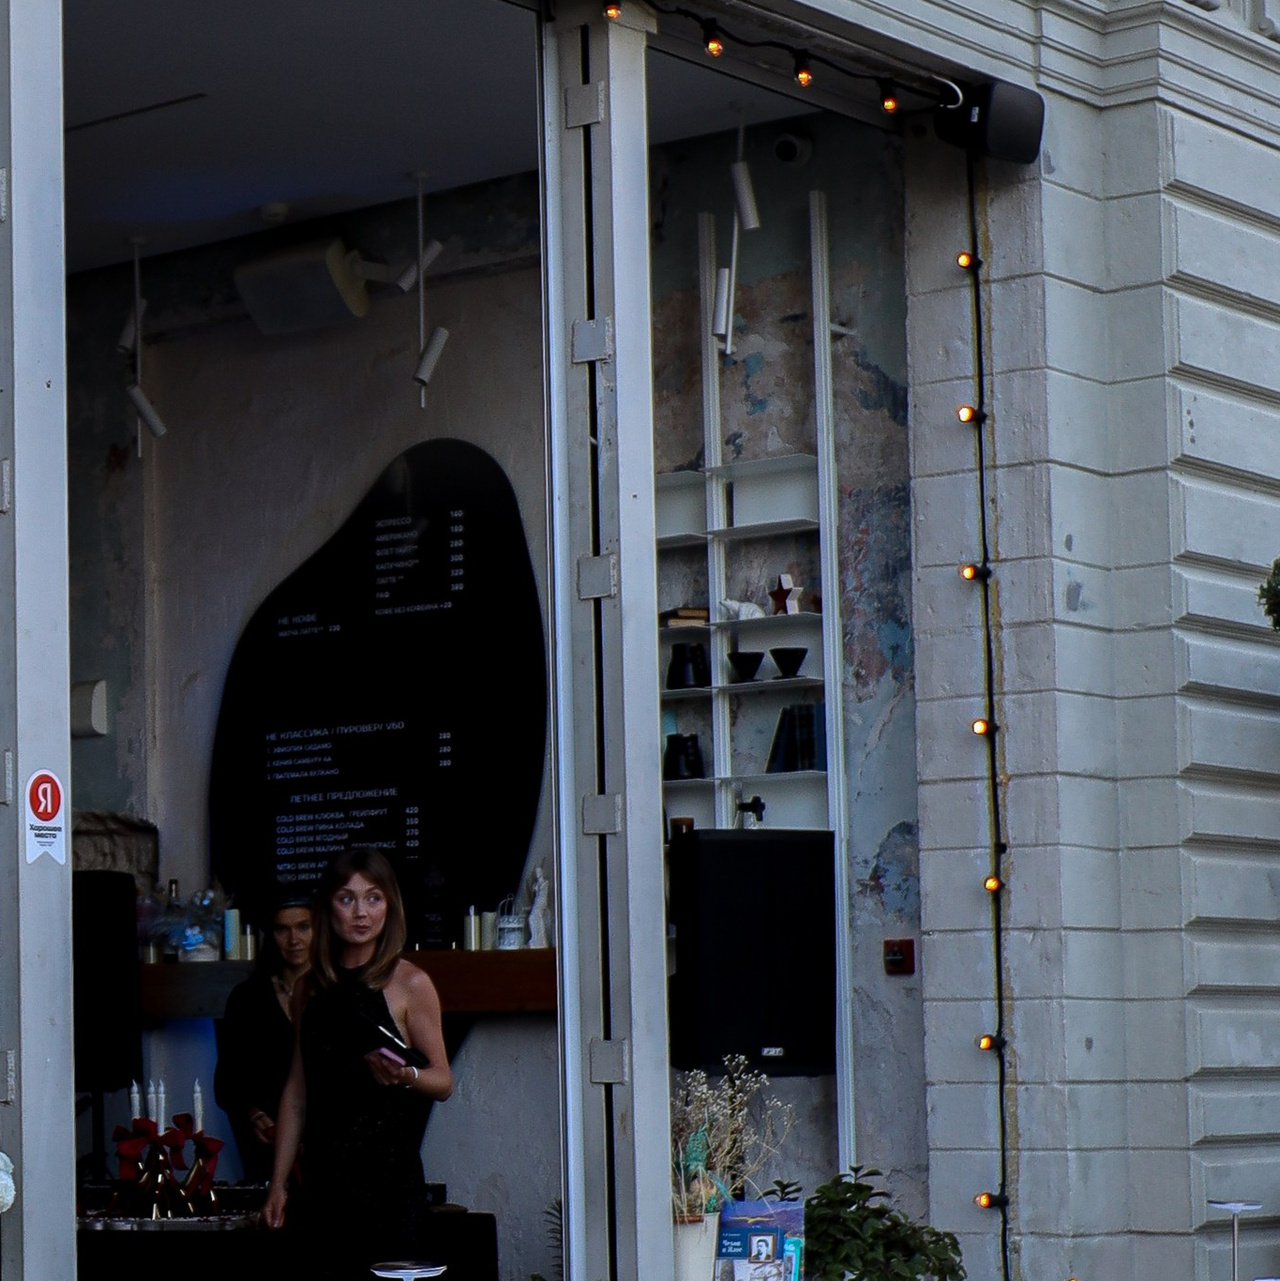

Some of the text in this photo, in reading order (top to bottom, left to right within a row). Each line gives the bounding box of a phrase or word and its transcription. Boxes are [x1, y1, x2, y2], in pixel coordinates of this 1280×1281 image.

[266, 732, 277, 741] НЕ
[280, 727, 329, 740] КЛАССИКА
[290, 787, 399, 804] ЛЕТНЕЕ ПРЕДЛОЖЕНИЕ
[276, 814, 294, 823] COLD
[295, 813, 314, 822] BREW
[29, 823, 62, 832] Хорошее
[276, 825, 294, 834] COLD
[295, 824, 314, 833] BREW
[335, 820, 365, 830] КОЛАДА
[276, 836, 294, 845] COLD
[295, 835, 314, 844] BREW
[276, 847, 295, 856] COLD
[295, 846, 314, 855] BREW
